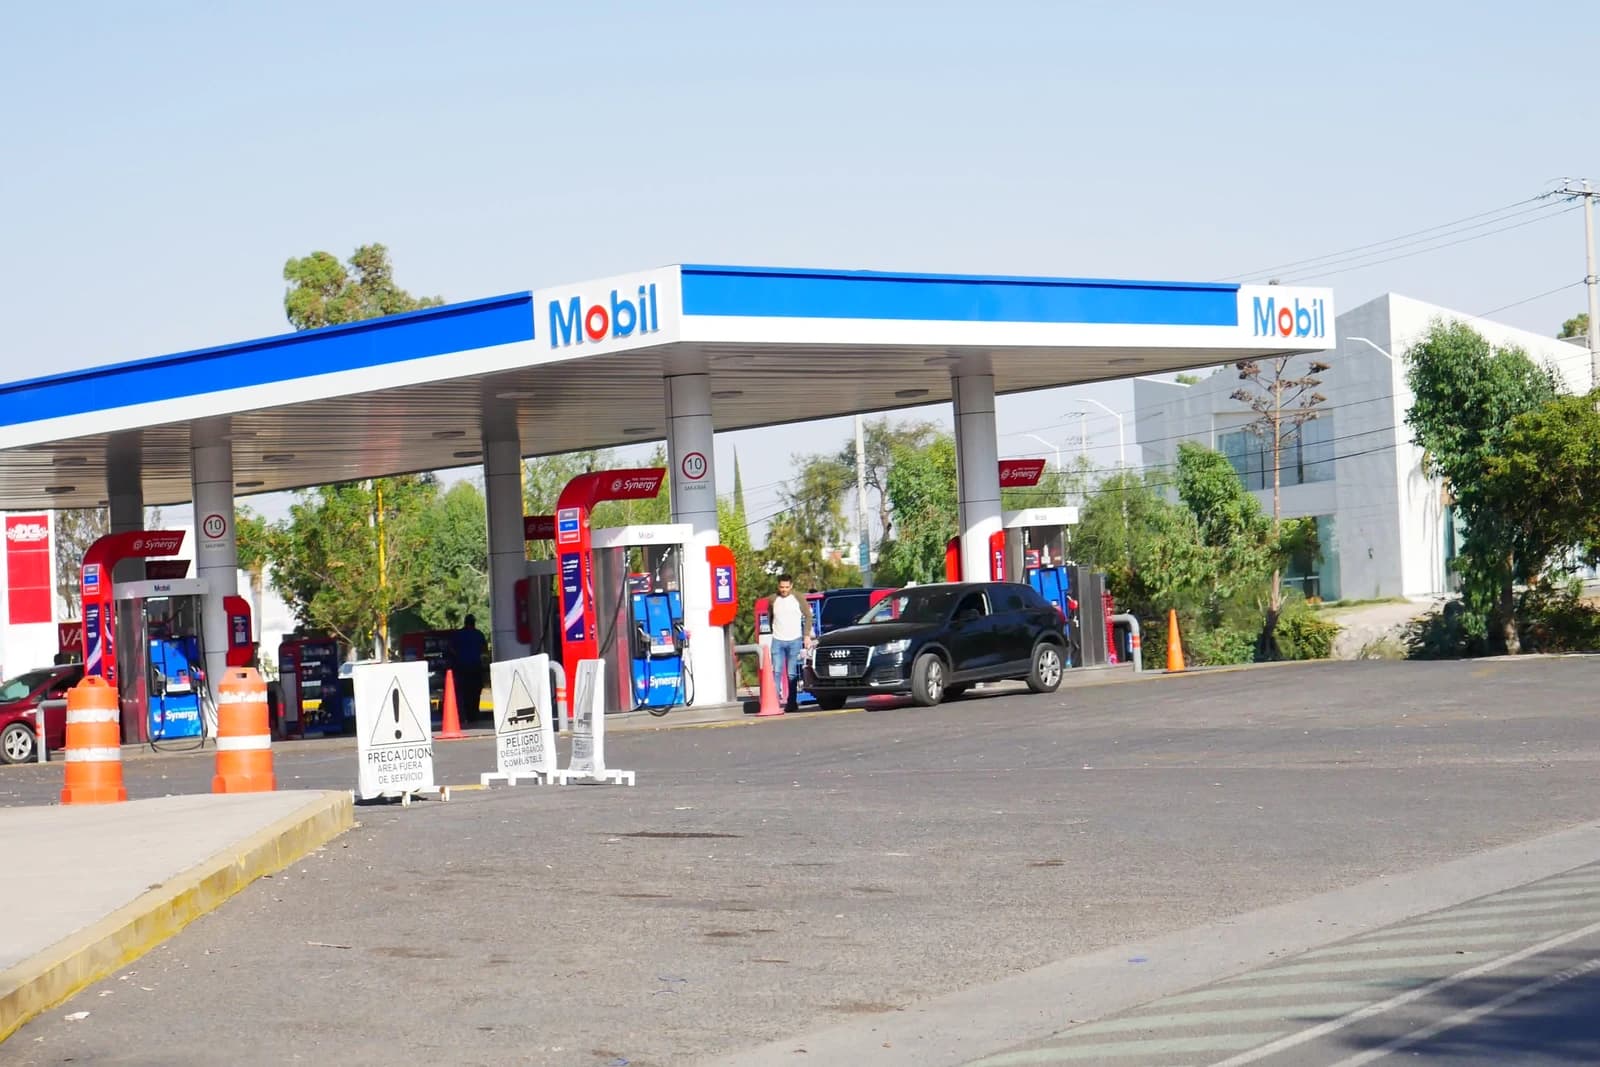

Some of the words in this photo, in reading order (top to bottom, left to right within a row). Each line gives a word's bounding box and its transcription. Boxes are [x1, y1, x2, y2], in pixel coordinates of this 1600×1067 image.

[549, 283, 659, 349] Mobil
[1253, 296, 1325, 338] Mobil
[687, 457, 703, 470] 10
[1010, 469, 1037, 480] Synergy
[623, 478, 657, 492] Synergy
[207, 519, 222, 530] 10
[144, 539, 178, 551] Synergy
[153, 584, 171, 592] Mobil
[649, 675, 681, 689] Synergy
[165, 709, 198, 722] Synergy
[505, 733, 540, 748] PELIGRO
[367, 747, 432, 763] PRECAUCION
[399, 760, 423, 771] FUERA
